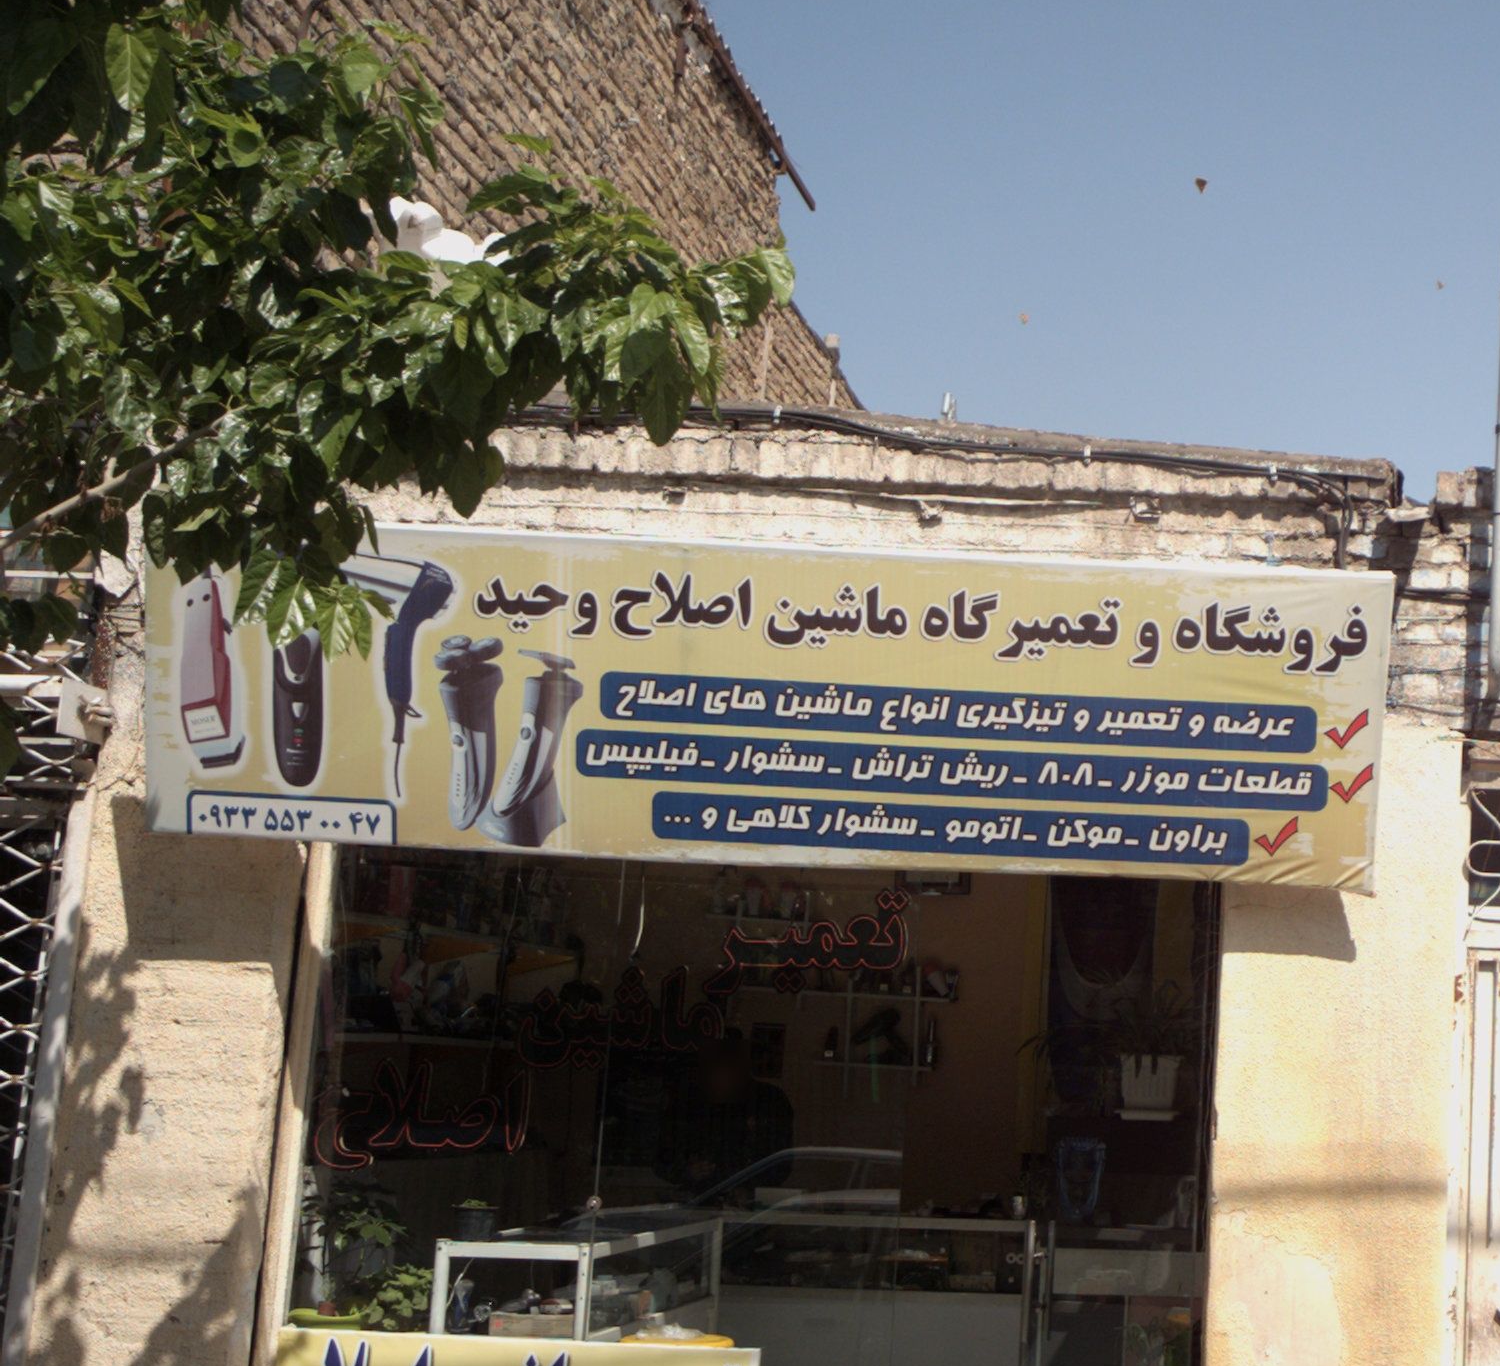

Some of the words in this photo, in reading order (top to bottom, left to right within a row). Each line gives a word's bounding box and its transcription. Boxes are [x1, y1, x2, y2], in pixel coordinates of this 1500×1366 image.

[475, 577, 599, 637] وحید
[613, 571, 752, 637] اصلاح
[766, 584, 909, 646] ماشین
[1130, 620, 1160, 667] و
[1174, 601, 1369, 674] فروشگاه
[615, 680, 697, 717] اصلاح
[703, 684, 767, 716] های
[774, 684, 873, 720] ماشین
[879, 693, 950, 732] انواع
[956, 697, 1068, 733] تیزگیری
[1073, 706, 1091, 733] و
[1096, 707, 1184, 736] تعمیر
[1188, 713, 1206, 738] و
[1213, 709, 1295, 740] عرضه
[851, 747, 935, 783] تراش
[1120, 765, 1190, 795] موزر
[1197, 767, 1313, 796] قطعات
[198, 804, 257, 829] ۰۹۳۳
[263, 807, 313, 833] ۵۵۳
[349, 811, 381, 835] ۴۷
[700, 806, 718, 831] و
[726, 804, 812, 833] کلاهی
[1148, 822, 1228, 856] براون
[704, 887, 912, 994] تعمیر
[516, 964, 725, 1069] ماشین
[313, 1058, 532, 1170] اصلاح
